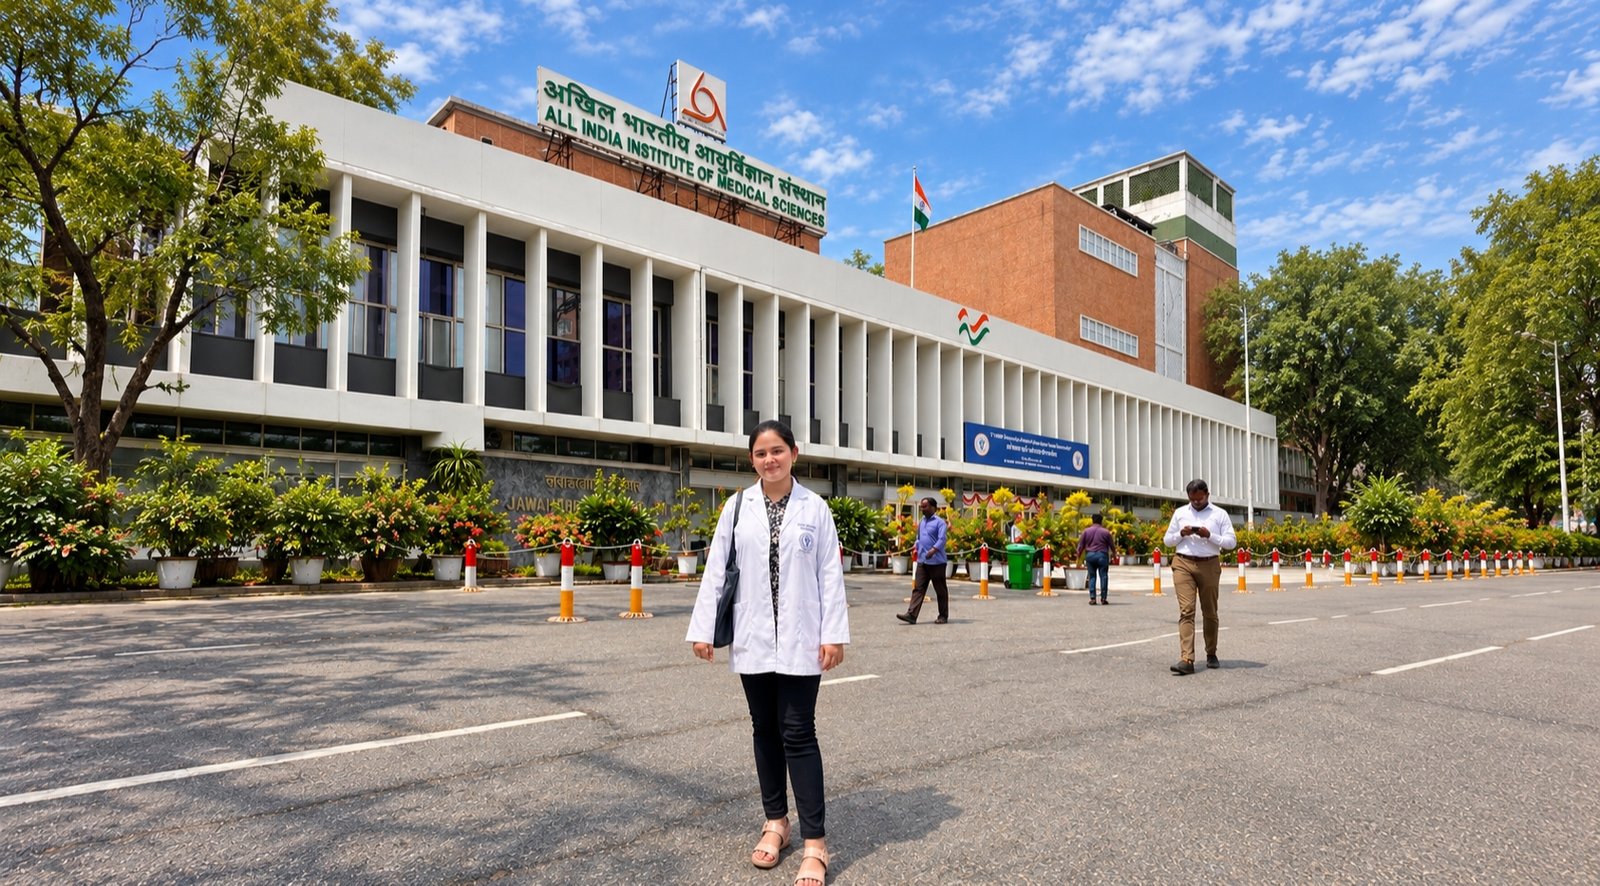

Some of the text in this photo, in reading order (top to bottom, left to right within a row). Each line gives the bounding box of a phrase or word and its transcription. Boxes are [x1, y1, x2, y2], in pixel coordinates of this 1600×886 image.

[544, 80, 616, 124] अखिल
[622, 112, 690, 153] भारतीय
[695, 143, 774, 189] आयुर्विज्ञान
[778, 176, 826, 211] संस्थान
[545, 105, 825, 227] ALL INDIA INSTITUTE OF MEDICAL SCIENCES
